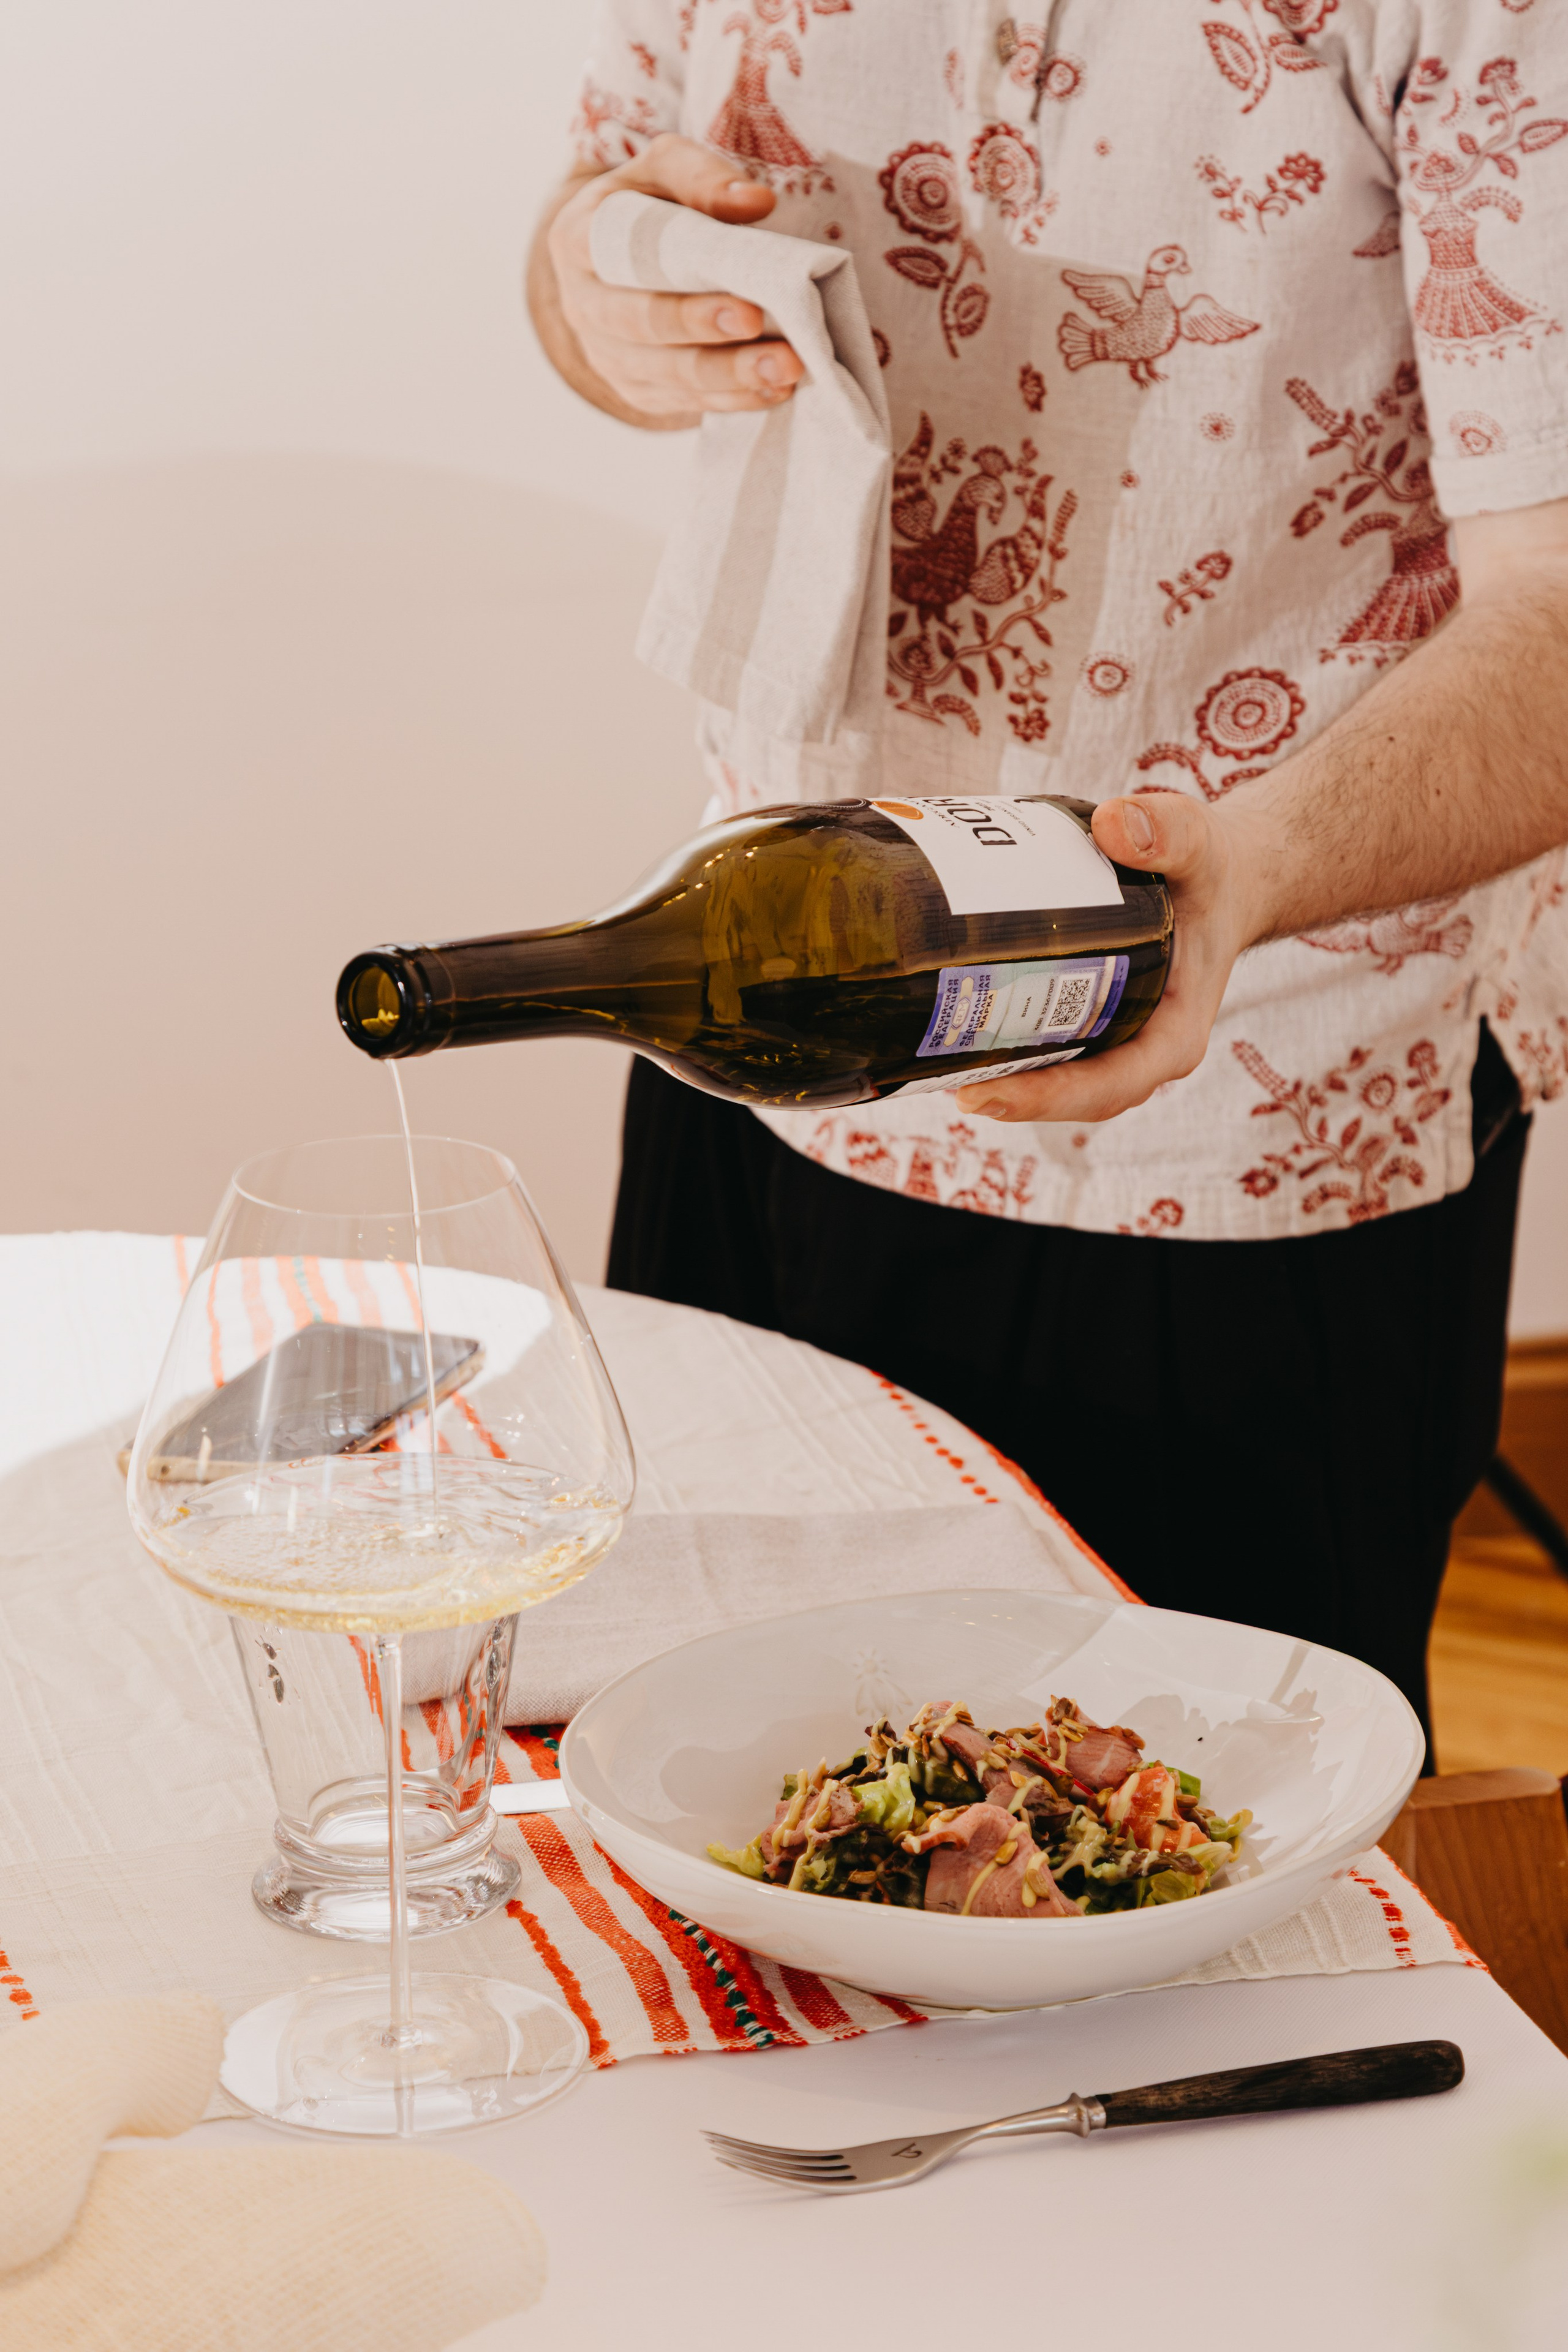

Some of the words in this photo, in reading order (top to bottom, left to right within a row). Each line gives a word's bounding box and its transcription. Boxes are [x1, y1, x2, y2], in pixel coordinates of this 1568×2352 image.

[907, 796, 1017, 845] DOR
[929, 979, 954, 1047] РОССИЙСКАЯ
[935, 979, 959, 1047] ФЕДЕРАЦИЯ
[959, 975, 985, 1046] ФЕДЕРАЛЬНАЯ
[965, 974, 991, 1046] СПЕЦИАЛЬНАЯ
[979, 994, 993, 1028] МАРКА
[1021, 997, 1032, 1017] ВИНА
